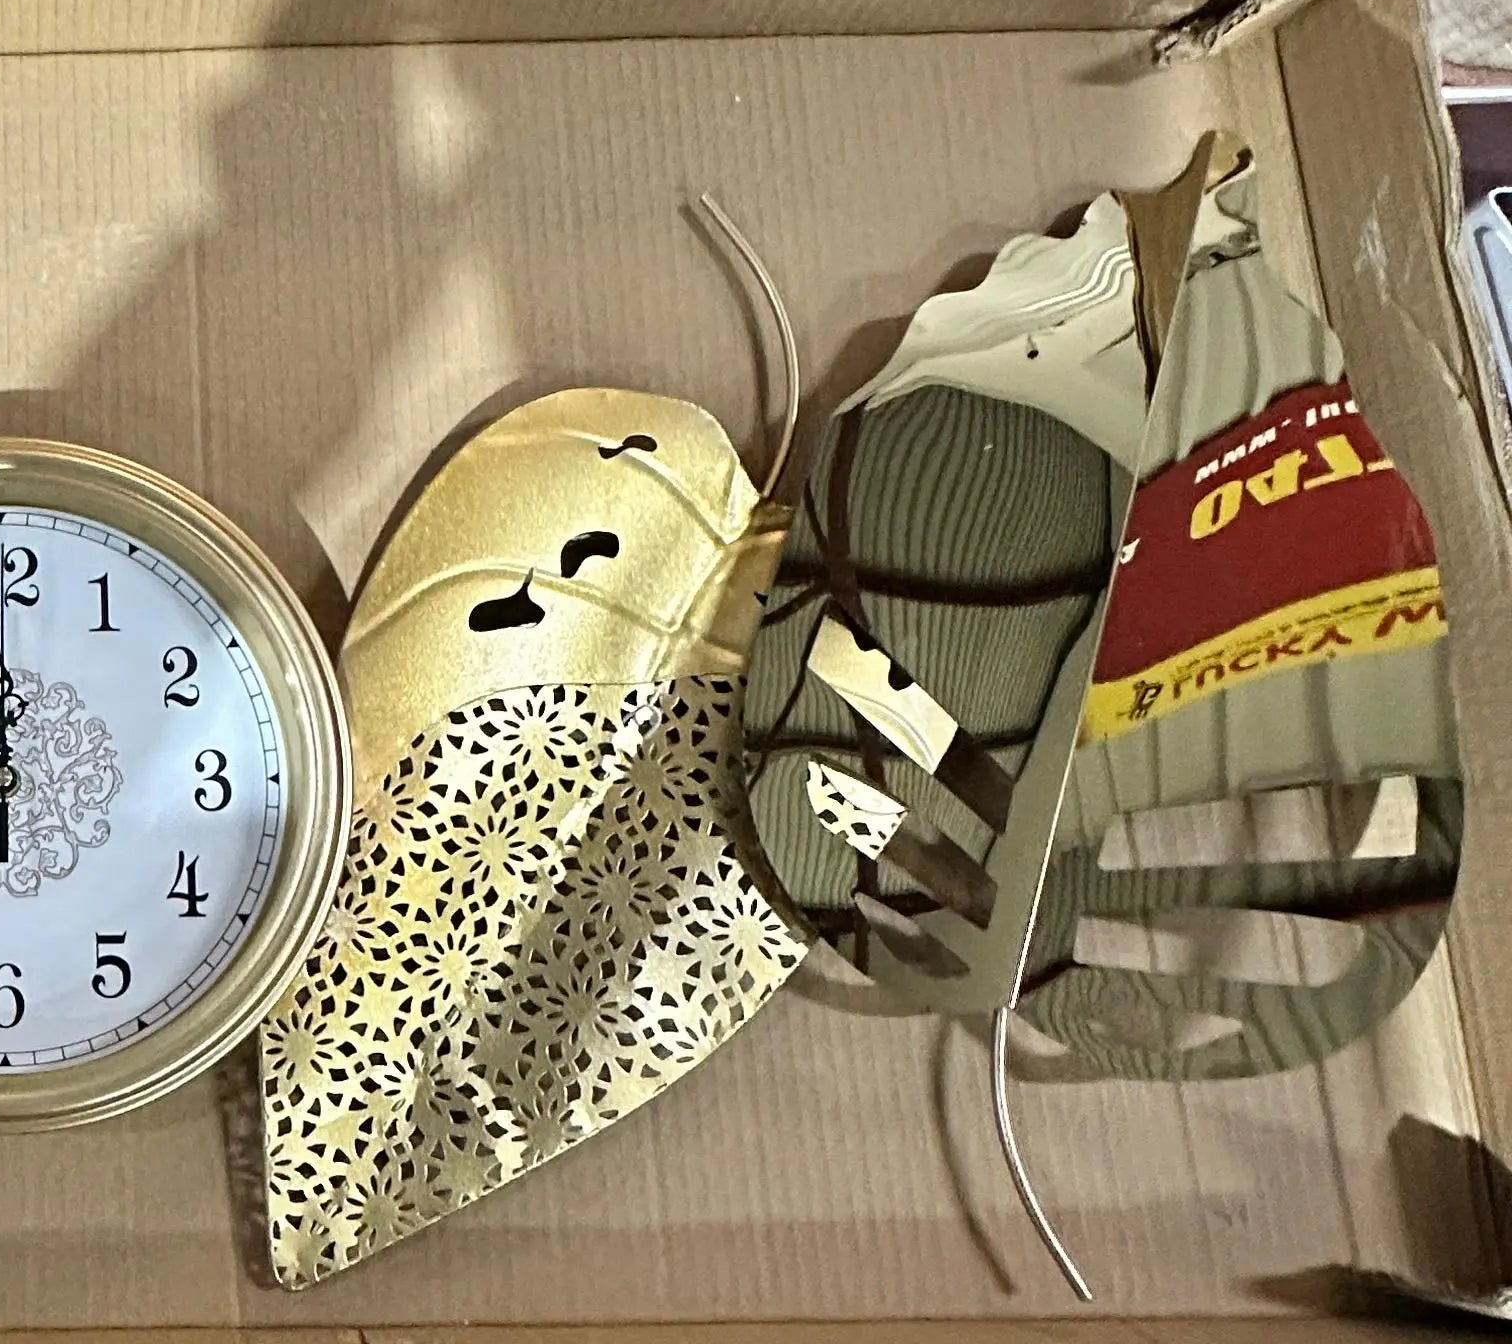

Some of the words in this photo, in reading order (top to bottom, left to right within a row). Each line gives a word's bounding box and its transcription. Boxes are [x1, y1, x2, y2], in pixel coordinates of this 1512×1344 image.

[87, 573, 121, 632] 1
[161, 646, 200, 708] 2
[193, 749, 232, 811] 3
[166, 850, 209, 918] 4
[91, 931, 131, 998] 5
